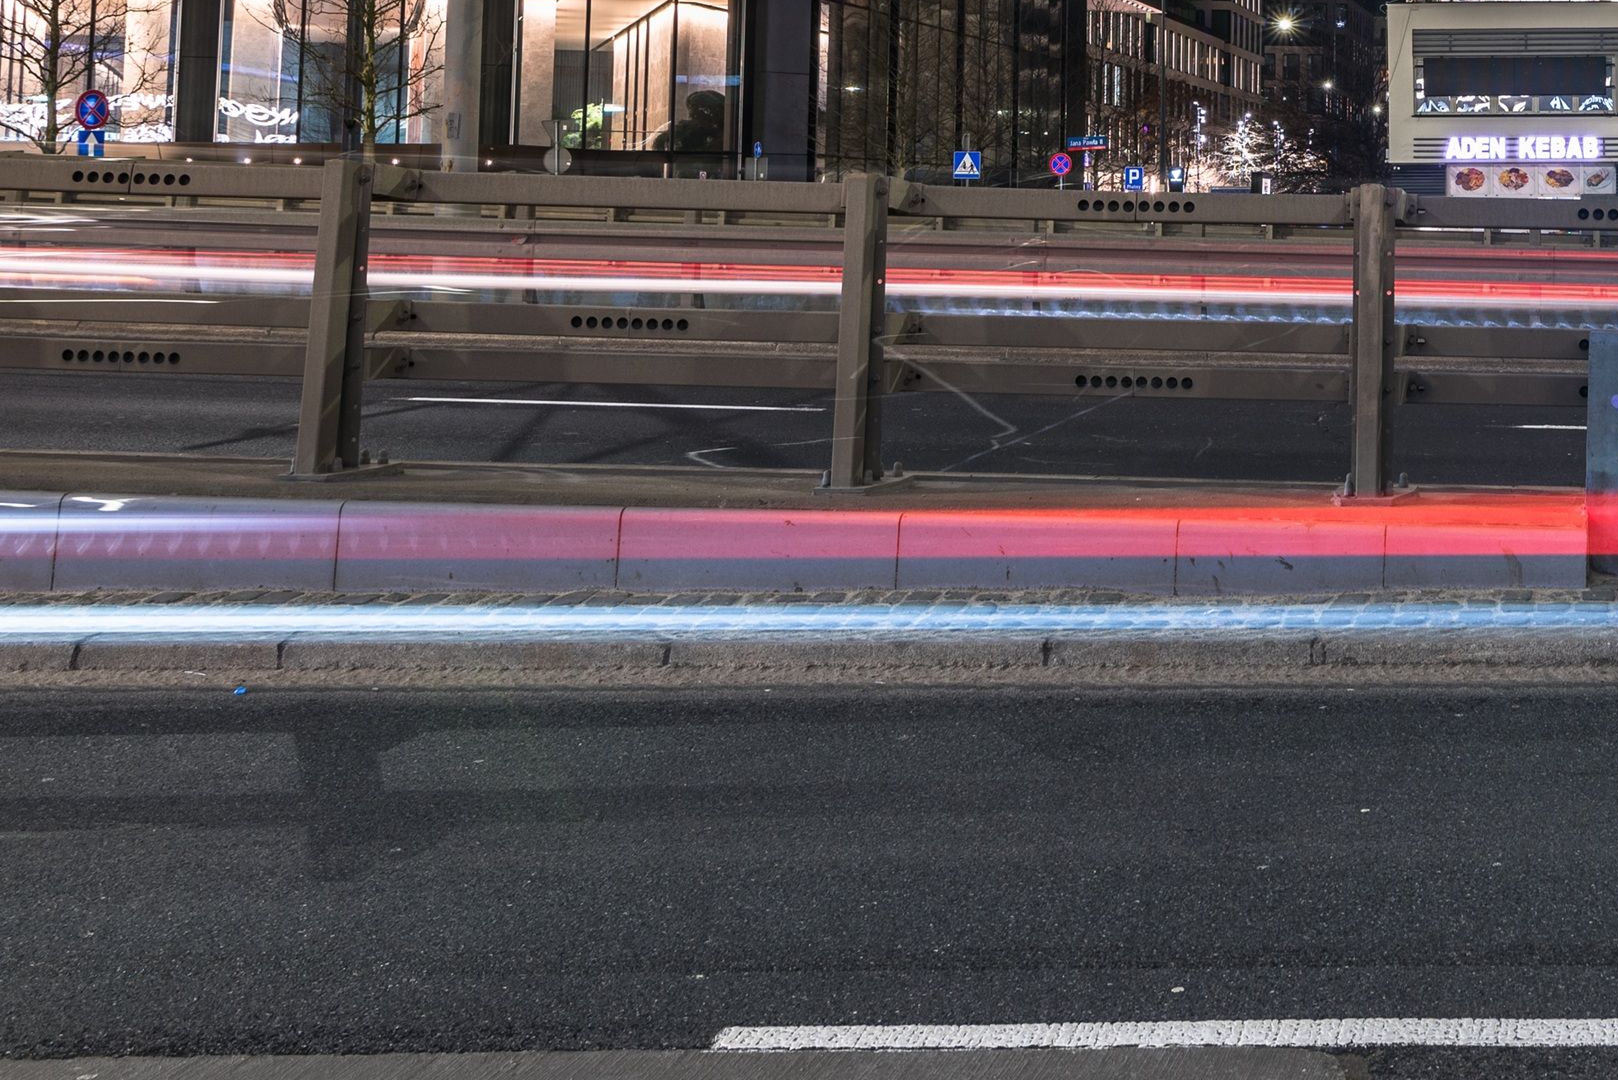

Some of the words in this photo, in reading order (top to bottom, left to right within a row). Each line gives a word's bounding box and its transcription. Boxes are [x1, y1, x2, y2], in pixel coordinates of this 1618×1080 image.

[1445, 136, 1506, 159] ADEN
[1518, 136, 1600, 159] KEBAB
[1129, 169, 1139, 184] P
